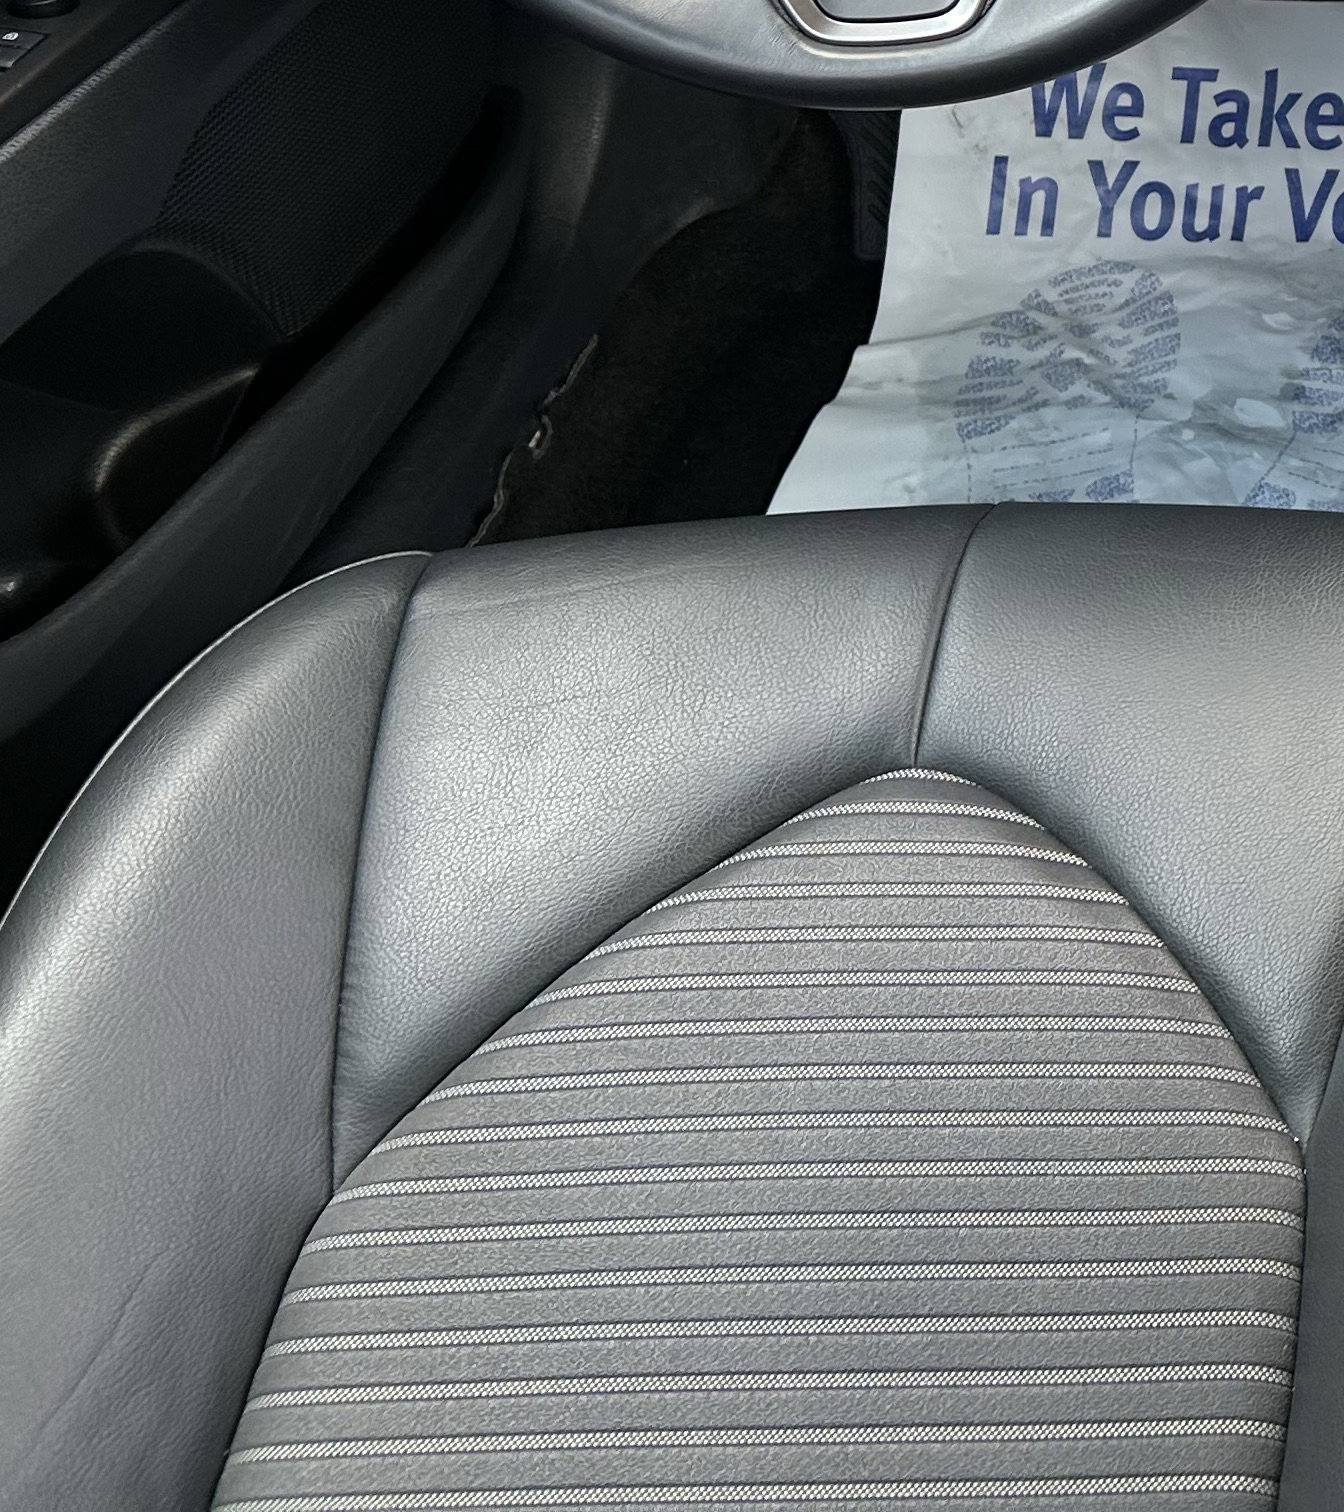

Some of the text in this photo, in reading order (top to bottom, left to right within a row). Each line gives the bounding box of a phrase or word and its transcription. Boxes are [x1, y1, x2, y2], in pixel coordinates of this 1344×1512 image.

[1030, 62, 1146, 142] We
[1171, 66, 1344, 151] Take
[985, 155, 1058, 238] In
[1087, 159, 1264, 244] Your
